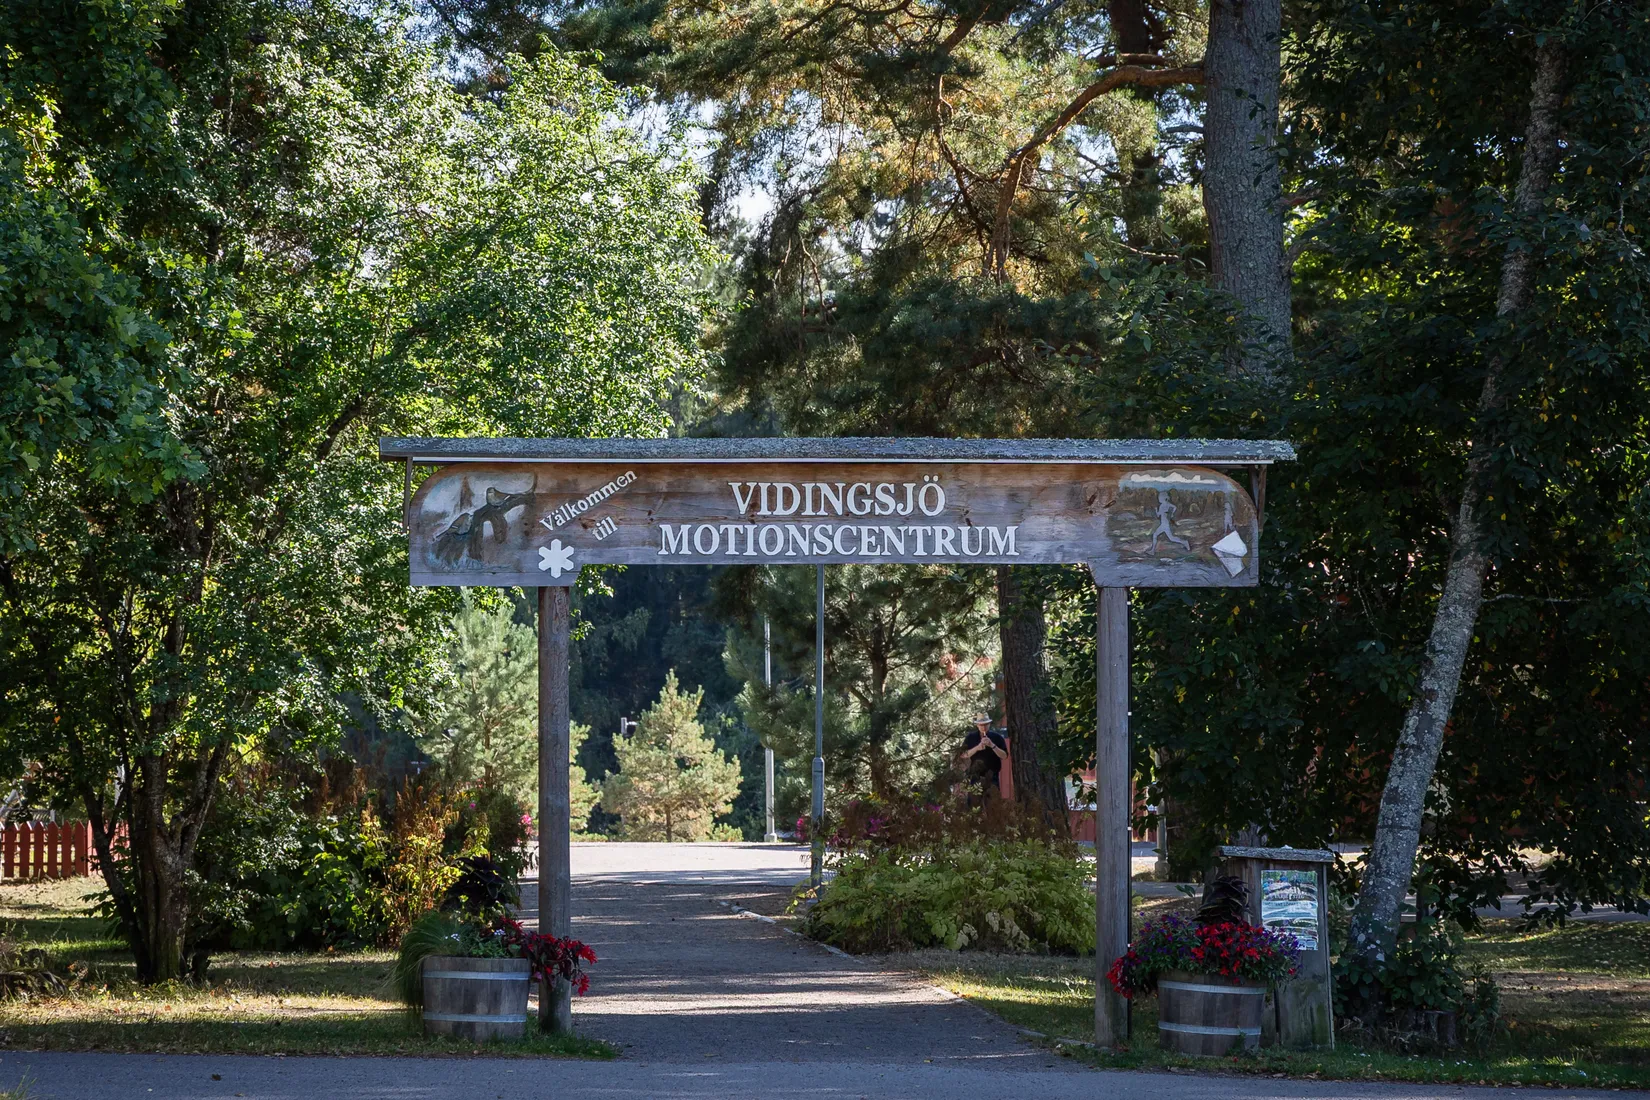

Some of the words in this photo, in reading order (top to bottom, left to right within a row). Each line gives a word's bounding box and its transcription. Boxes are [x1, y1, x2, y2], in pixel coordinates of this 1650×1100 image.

[539, 470, 637, 532] Välkommen
[728, 474, 946, 516] VIDINGSJÖ
[592, 516, 618, 541] till
[657, 523, 1020, 556] MOTIONSCENTRUM
